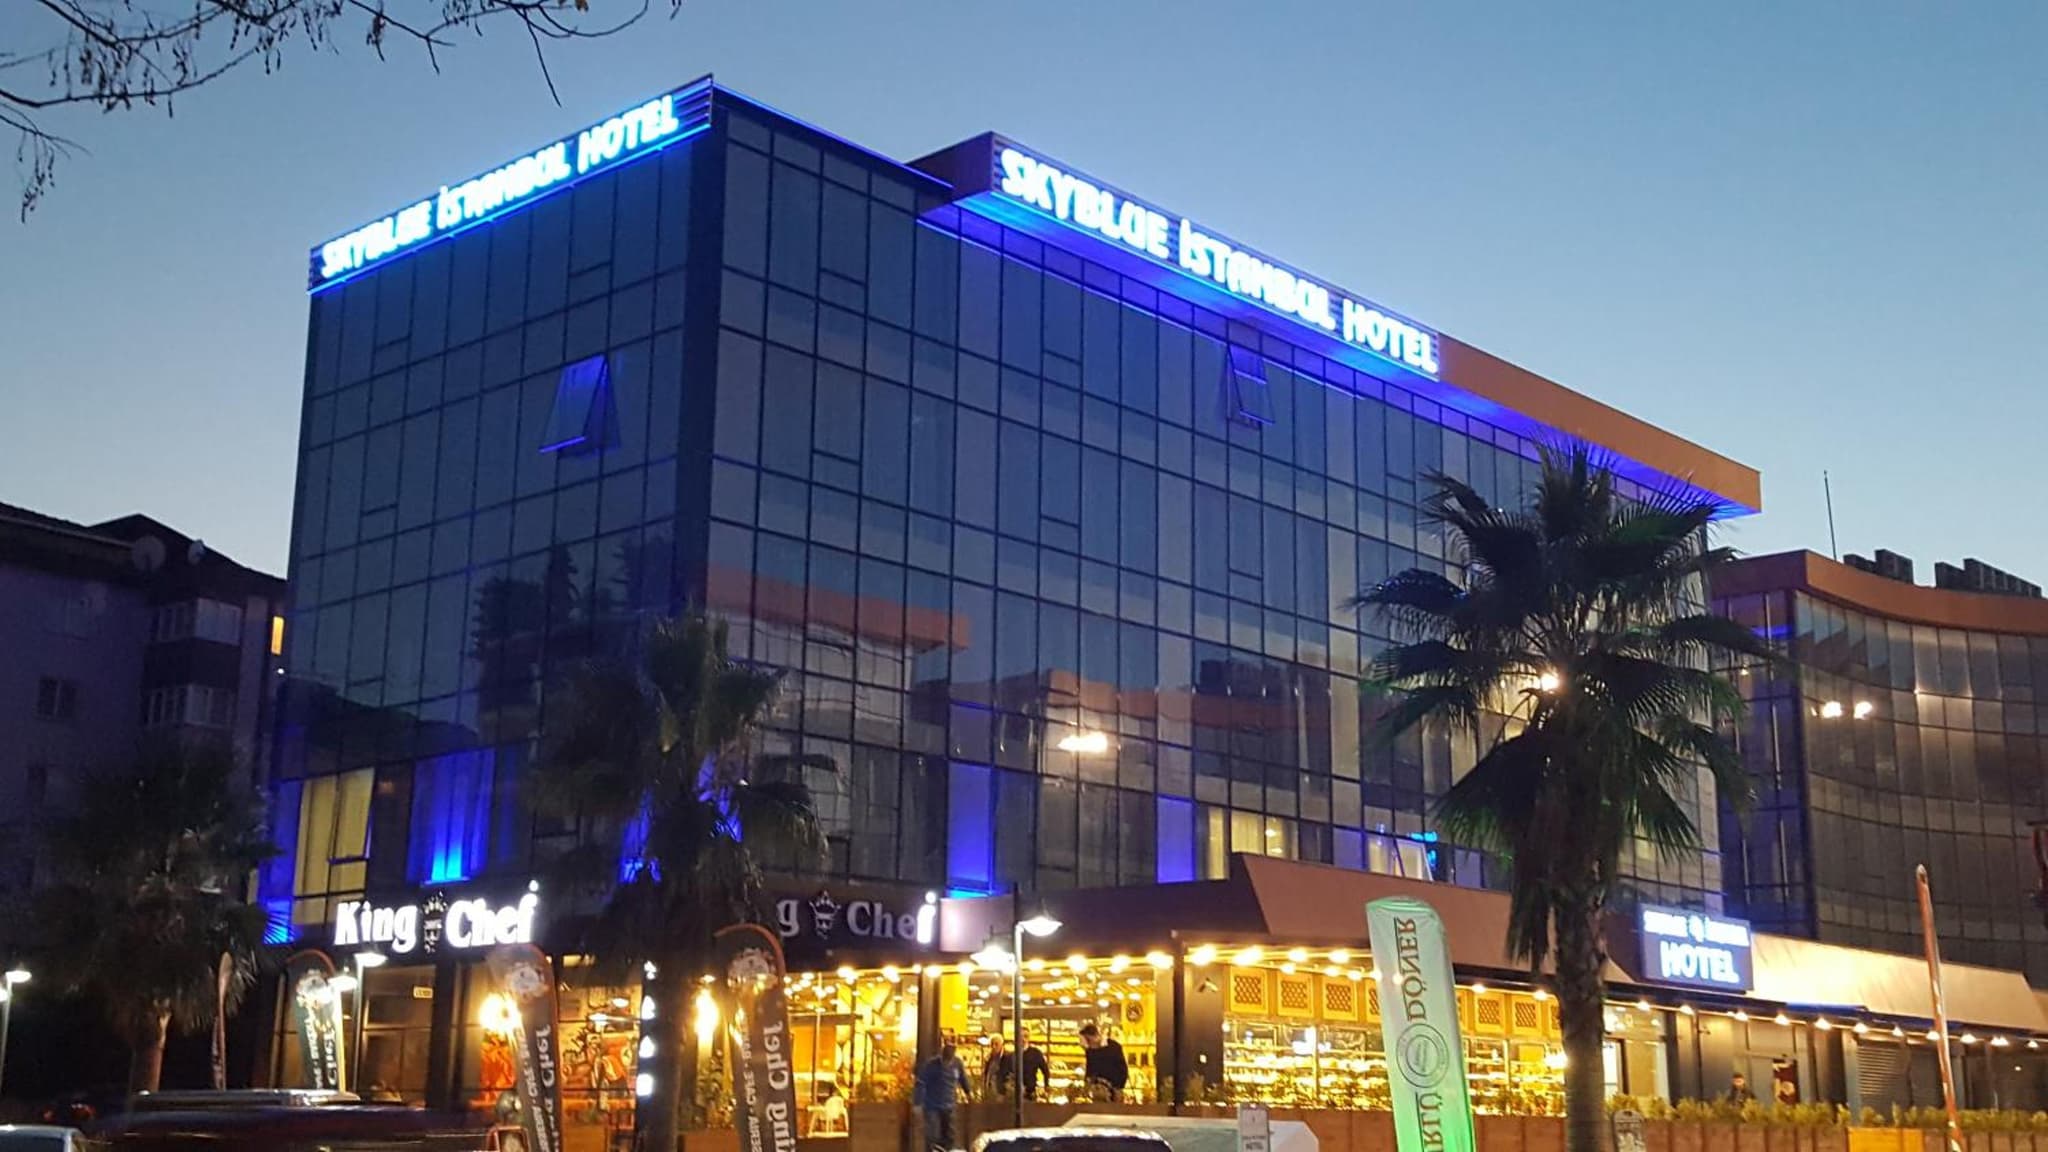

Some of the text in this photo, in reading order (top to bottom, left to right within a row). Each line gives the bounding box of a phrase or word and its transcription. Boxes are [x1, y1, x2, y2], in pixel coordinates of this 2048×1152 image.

[577, 94, 679, 173] HOTEL
[1000, 147, 1170, 259] SKYBLUE
[1342, 298, 1439, 374] HOTEL
[334, 880, 539, 953] King Chef
[847, 891, 936, 944] Chef
[1660, 940, 1740, 984] HOTEL
